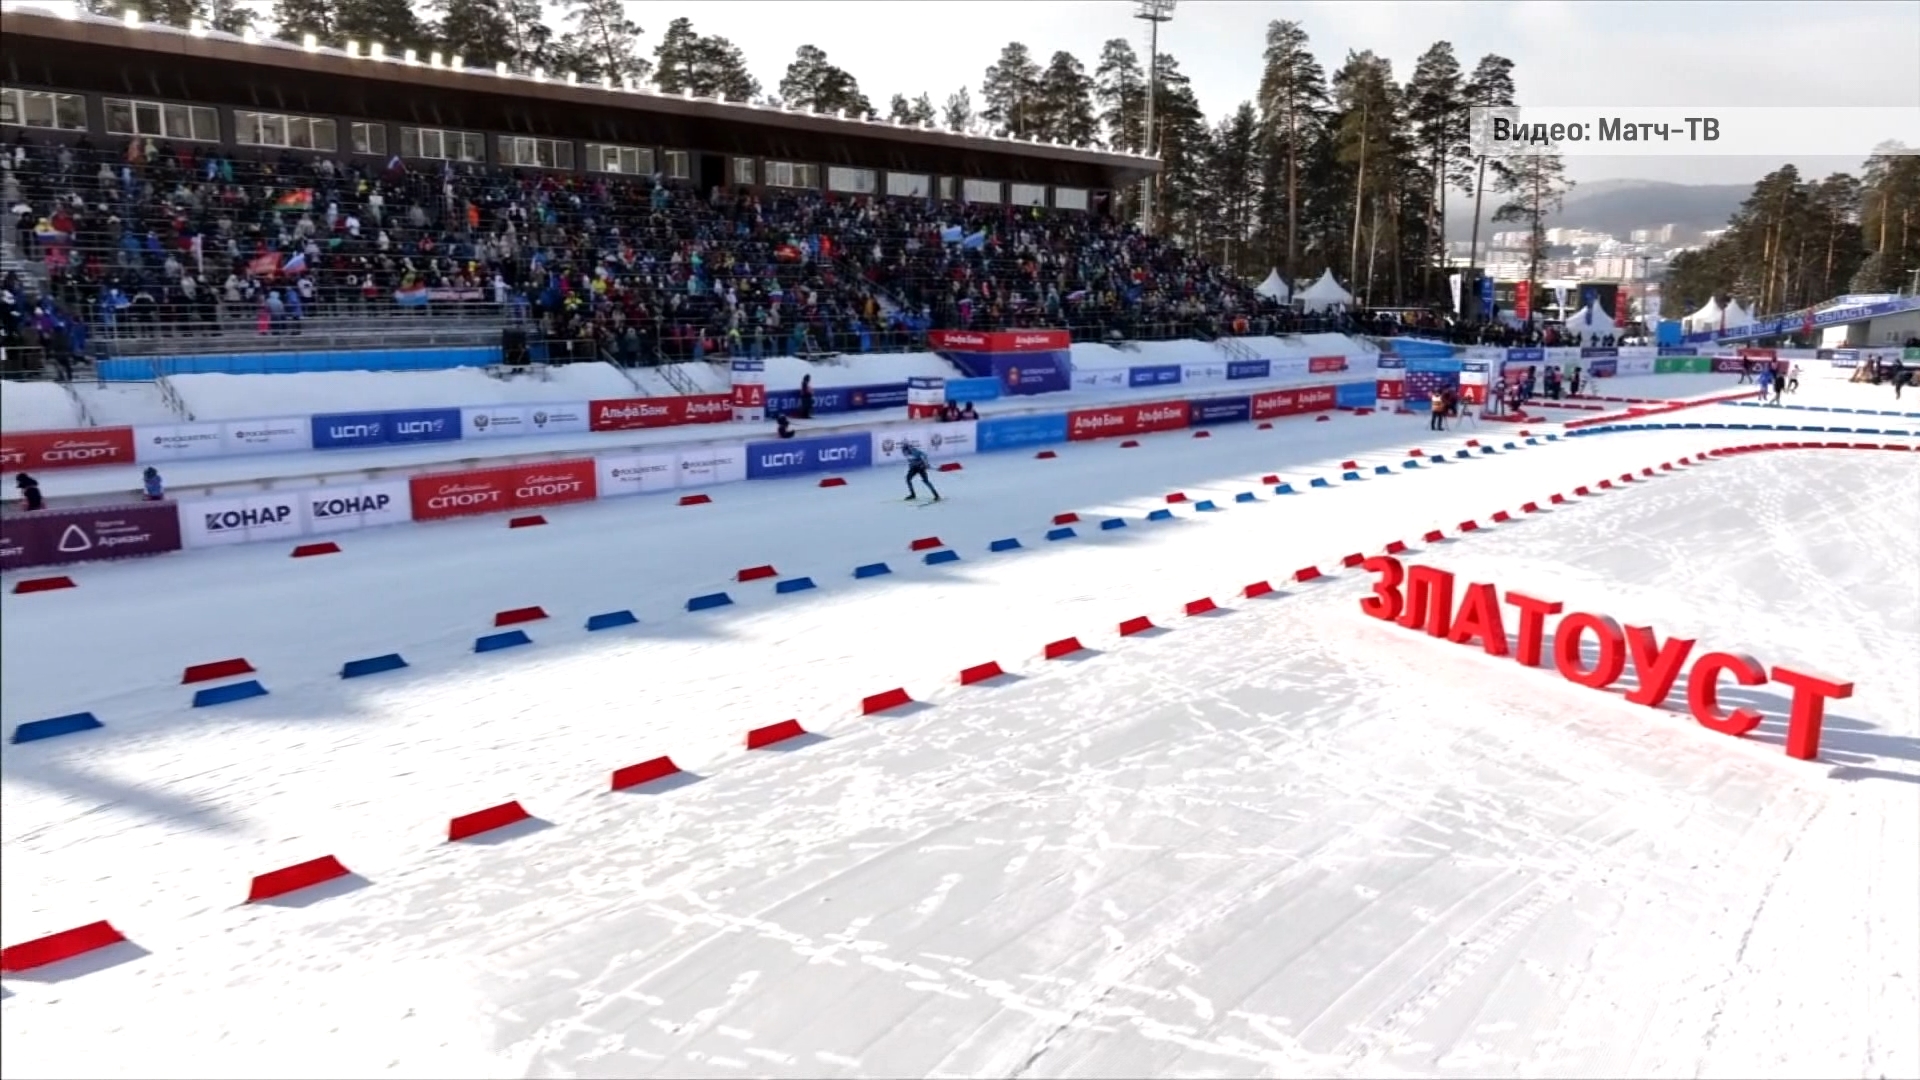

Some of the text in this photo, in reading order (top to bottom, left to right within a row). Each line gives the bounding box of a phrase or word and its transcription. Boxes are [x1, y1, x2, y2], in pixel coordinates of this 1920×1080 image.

[1815, 307, 1872, 322] ОБЛАСТЬ
[42, 446, 119, 461] СПОРТ
[515, 481, 583, 498] СПОРТ
[313, 493, 392, 518] КОНАР
[428, 490, 502, 509] СПОРТ
[205, 505, 292, 531] КОНАР
[1360, 556, 1854, 761] ЗЛАТОУСТ
